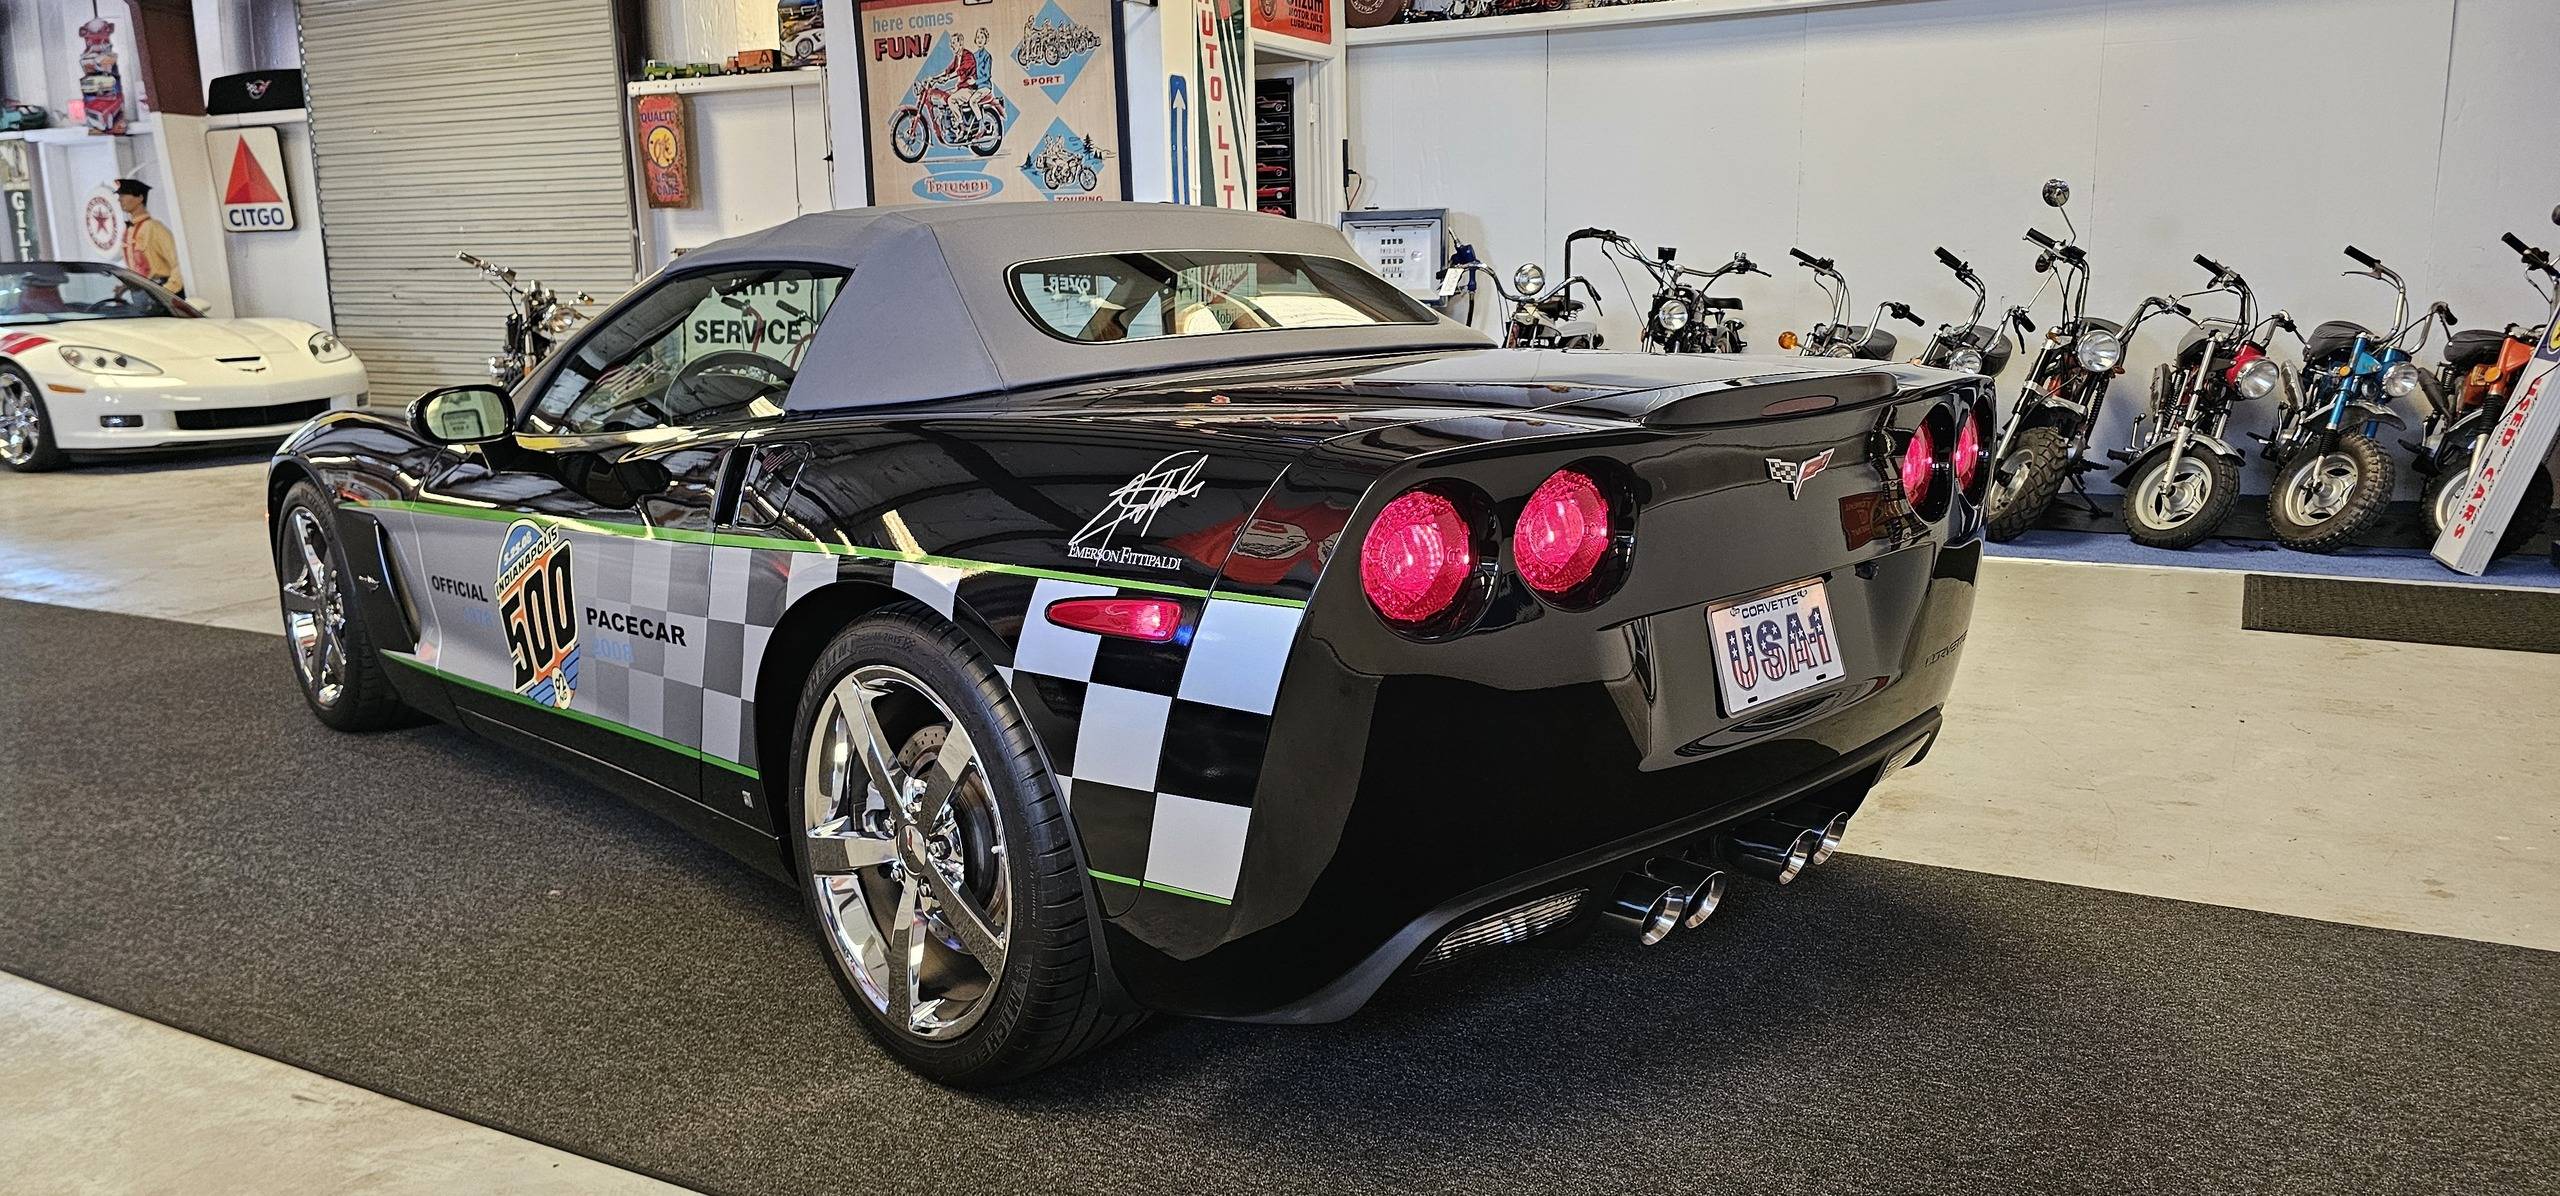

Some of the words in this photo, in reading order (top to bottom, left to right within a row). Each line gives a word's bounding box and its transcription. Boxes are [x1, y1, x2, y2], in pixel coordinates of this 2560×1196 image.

[873, 16, 903, 33] here
[909, 12, 954, 29] comes
[1289, 7, 1309, 20] MOTOR
[1310, 12, 1323, 23] OILS
[1290, 19, 1323, 33] LUBRICANTS
[874, 33, 932, 62] FUN!
[1023, 76, 1061, 86] SPORT
[927, 176, 989, 194] TRIUMPH
[229, 207, 285, 227] CITGO
[694, 319, 803, 345] SERVICE
[2453, 466, 2495, 540] CARS
[495, 526, 558, 596] INDIANAPOLIS
[432, 575, 489, 603] OFFICIAL
[501, 543, 577, 691] 500
[1740, 594, 1800, 620] CORVETTE
[586, 606, 687, 648] PACECAR
